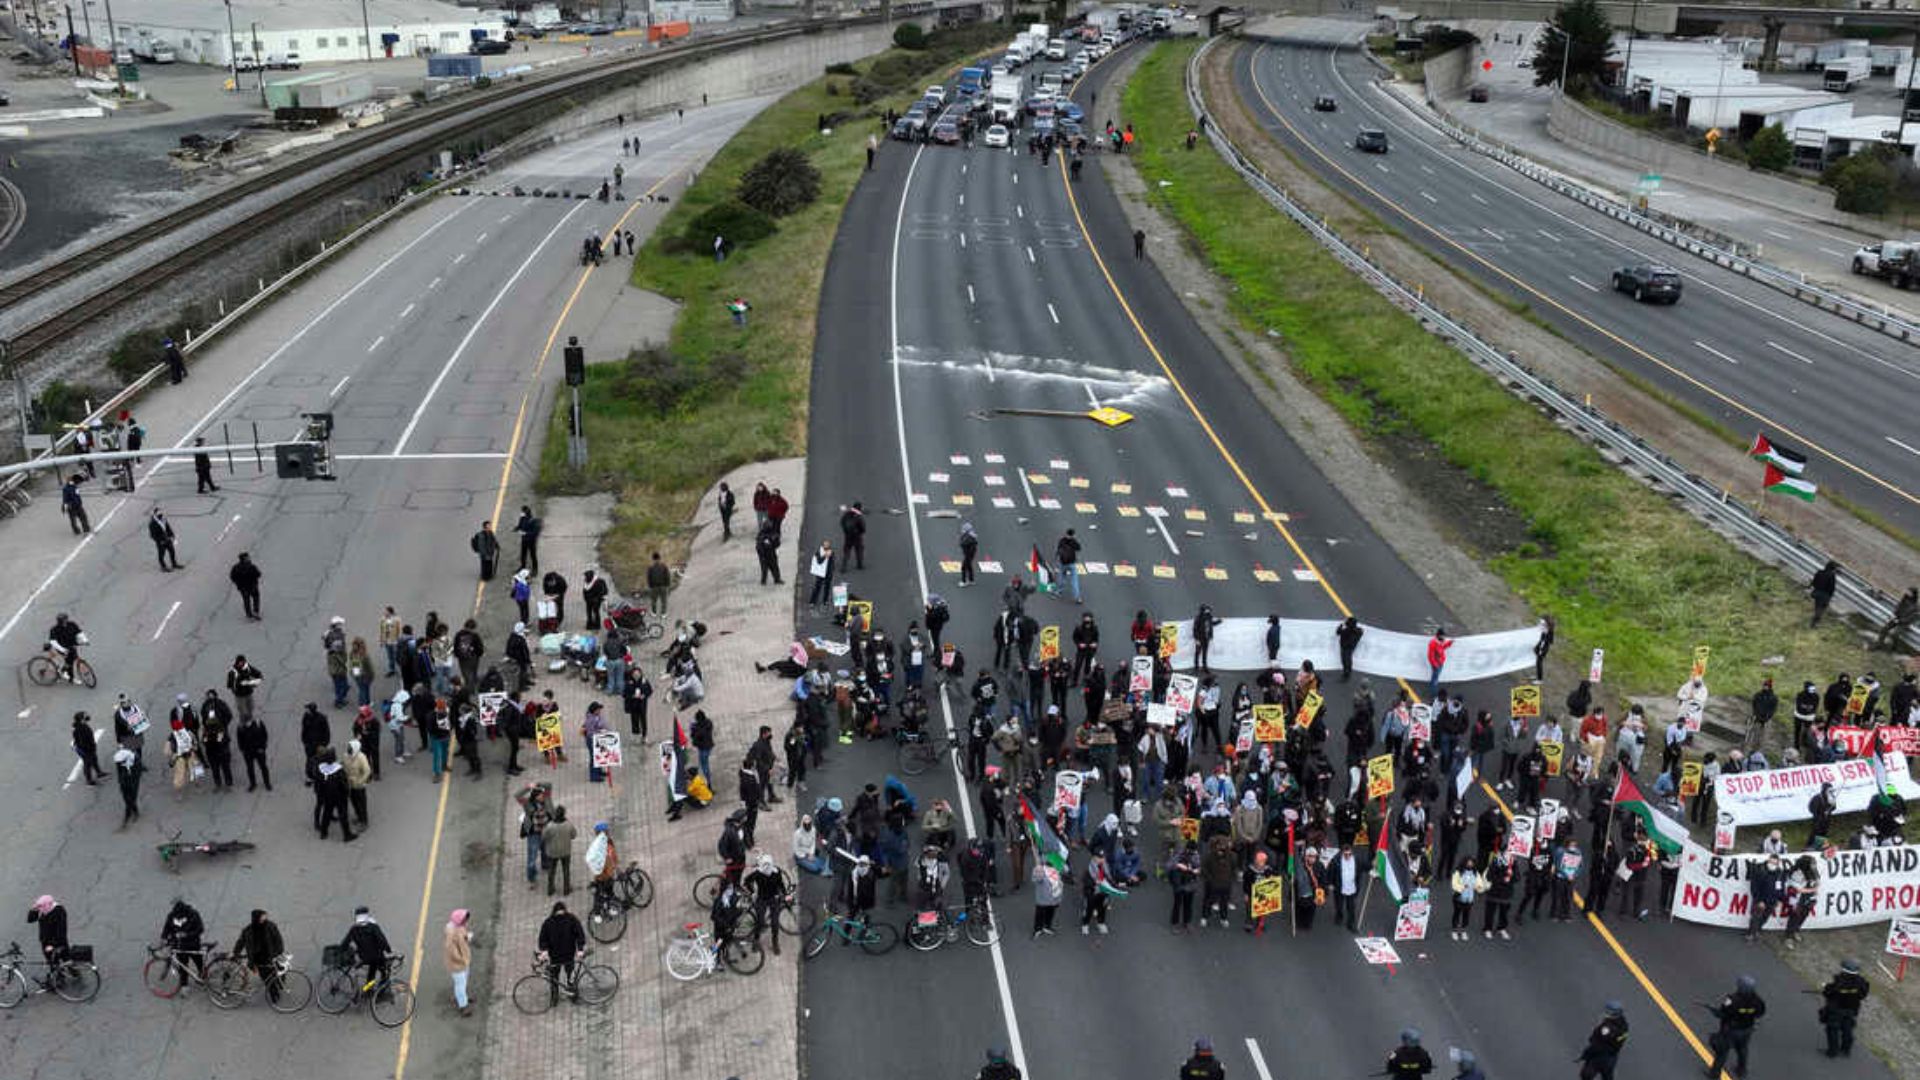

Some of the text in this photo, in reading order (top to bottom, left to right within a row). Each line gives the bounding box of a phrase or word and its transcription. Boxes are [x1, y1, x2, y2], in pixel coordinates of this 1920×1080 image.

[1726, 775, 1764, 794] STOP
[1769, 767, 1836, 790] ARMING
[1827, 848, 1918, 878] DEMAND
[1682, 883, 1720, 911] NO
[1825, 890, 1863, 916] FOR
